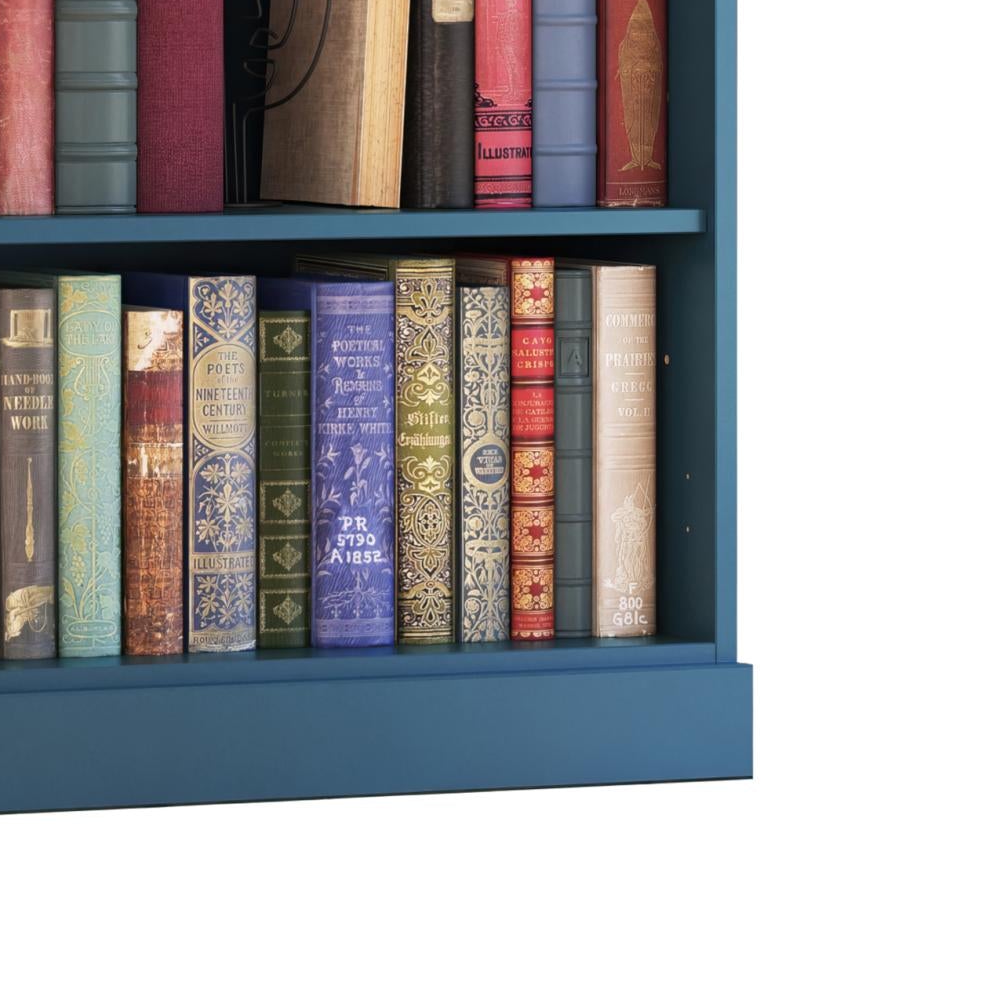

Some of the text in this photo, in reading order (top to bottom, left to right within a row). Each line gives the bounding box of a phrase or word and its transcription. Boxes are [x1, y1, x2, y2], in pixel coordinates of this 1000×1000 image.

[347, 325, 371, 335] THE
[331, 340, 385, 352] POETICAL
[522, 337, 551, 345] CAYO
[218, 351, 238, 360] THE
[333, 356, 380, 368] WORKS
[207, 363, 246, 375] POETS
[3, 395, 54, 410] NEEDLE
[202, 403, 248, 417] CENTURY
[337, 407, 378, 418] HENRY
[11, 416, 49, 430] WORK
[202, 423, 249, 435] WILLMOTT
[318, 422, 354, 434] KIRKE
[337, 516, 368, 531] PR
[337, 533, 376, 546] 5790
[193, 557, 250, 569] ILLUSTRATE
[628, 582, 639, 594] F
[618, 597, 643, 610] 800
